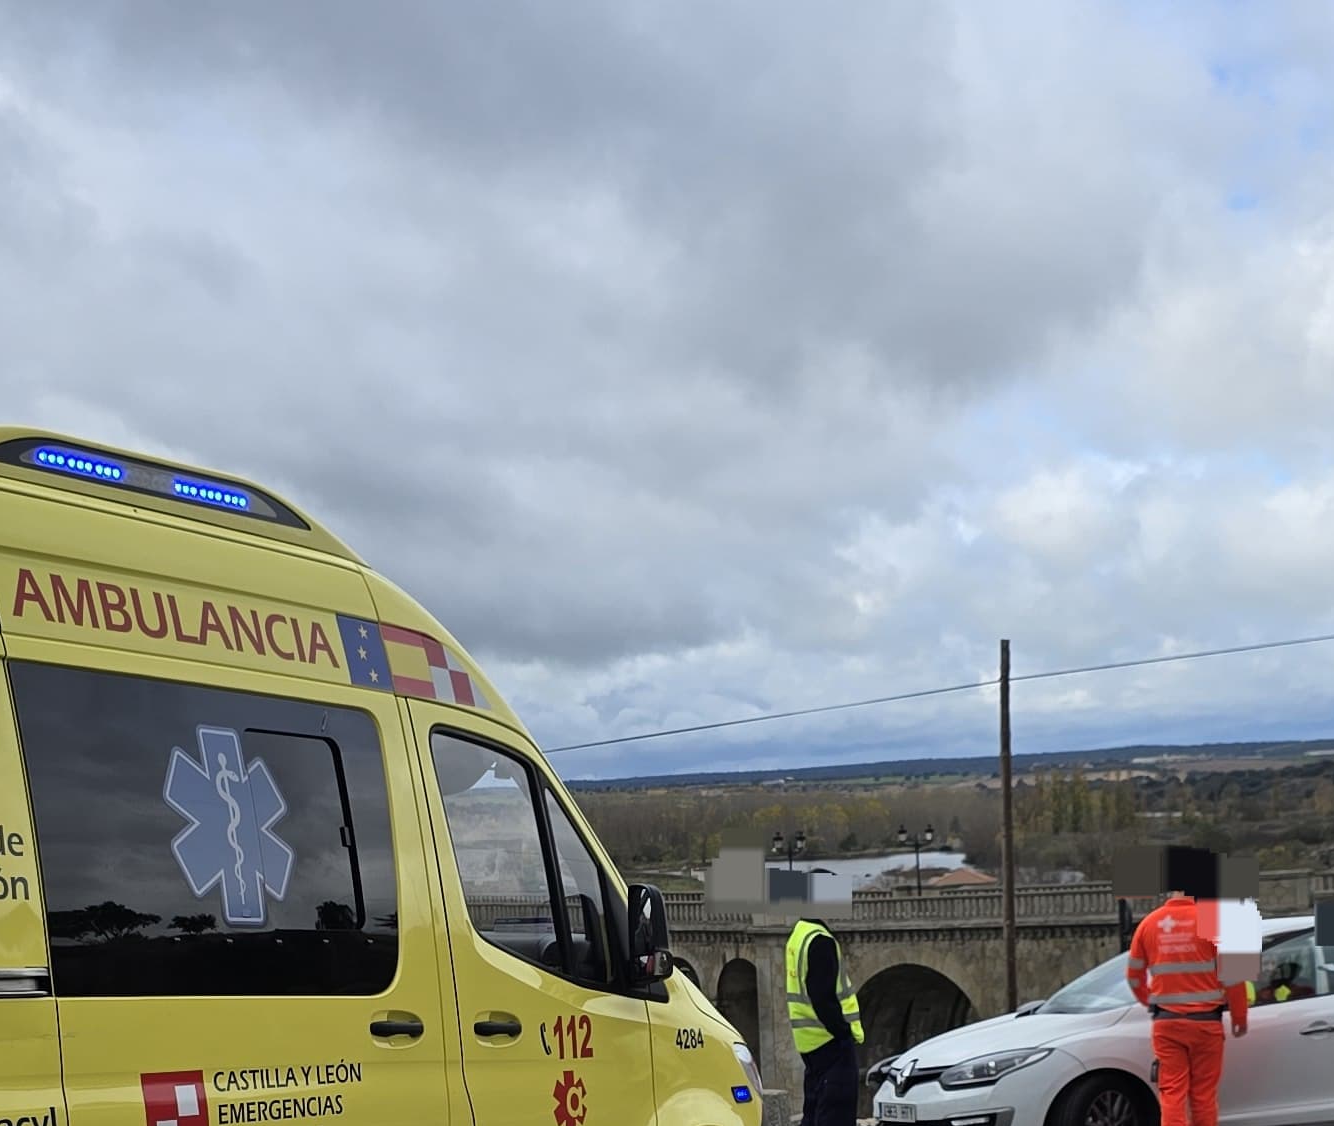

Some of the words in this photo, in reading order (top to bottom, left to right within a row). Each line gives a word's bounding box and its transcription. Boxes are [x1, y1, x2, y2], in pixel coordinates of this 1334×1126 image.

[12, 568, 340, 668] AMBULANCIA
[553, 1014, 594, 1060] 112
[675, 1028, 704, 1050] 4284
[213, 1066, 298, 1092] CASTILLA
[300, 1065, 312, 1086] Y
[316, 1058, 362, 1085] LEÓN
[218, 1094, 343, 1125] EMERGENCIAS
